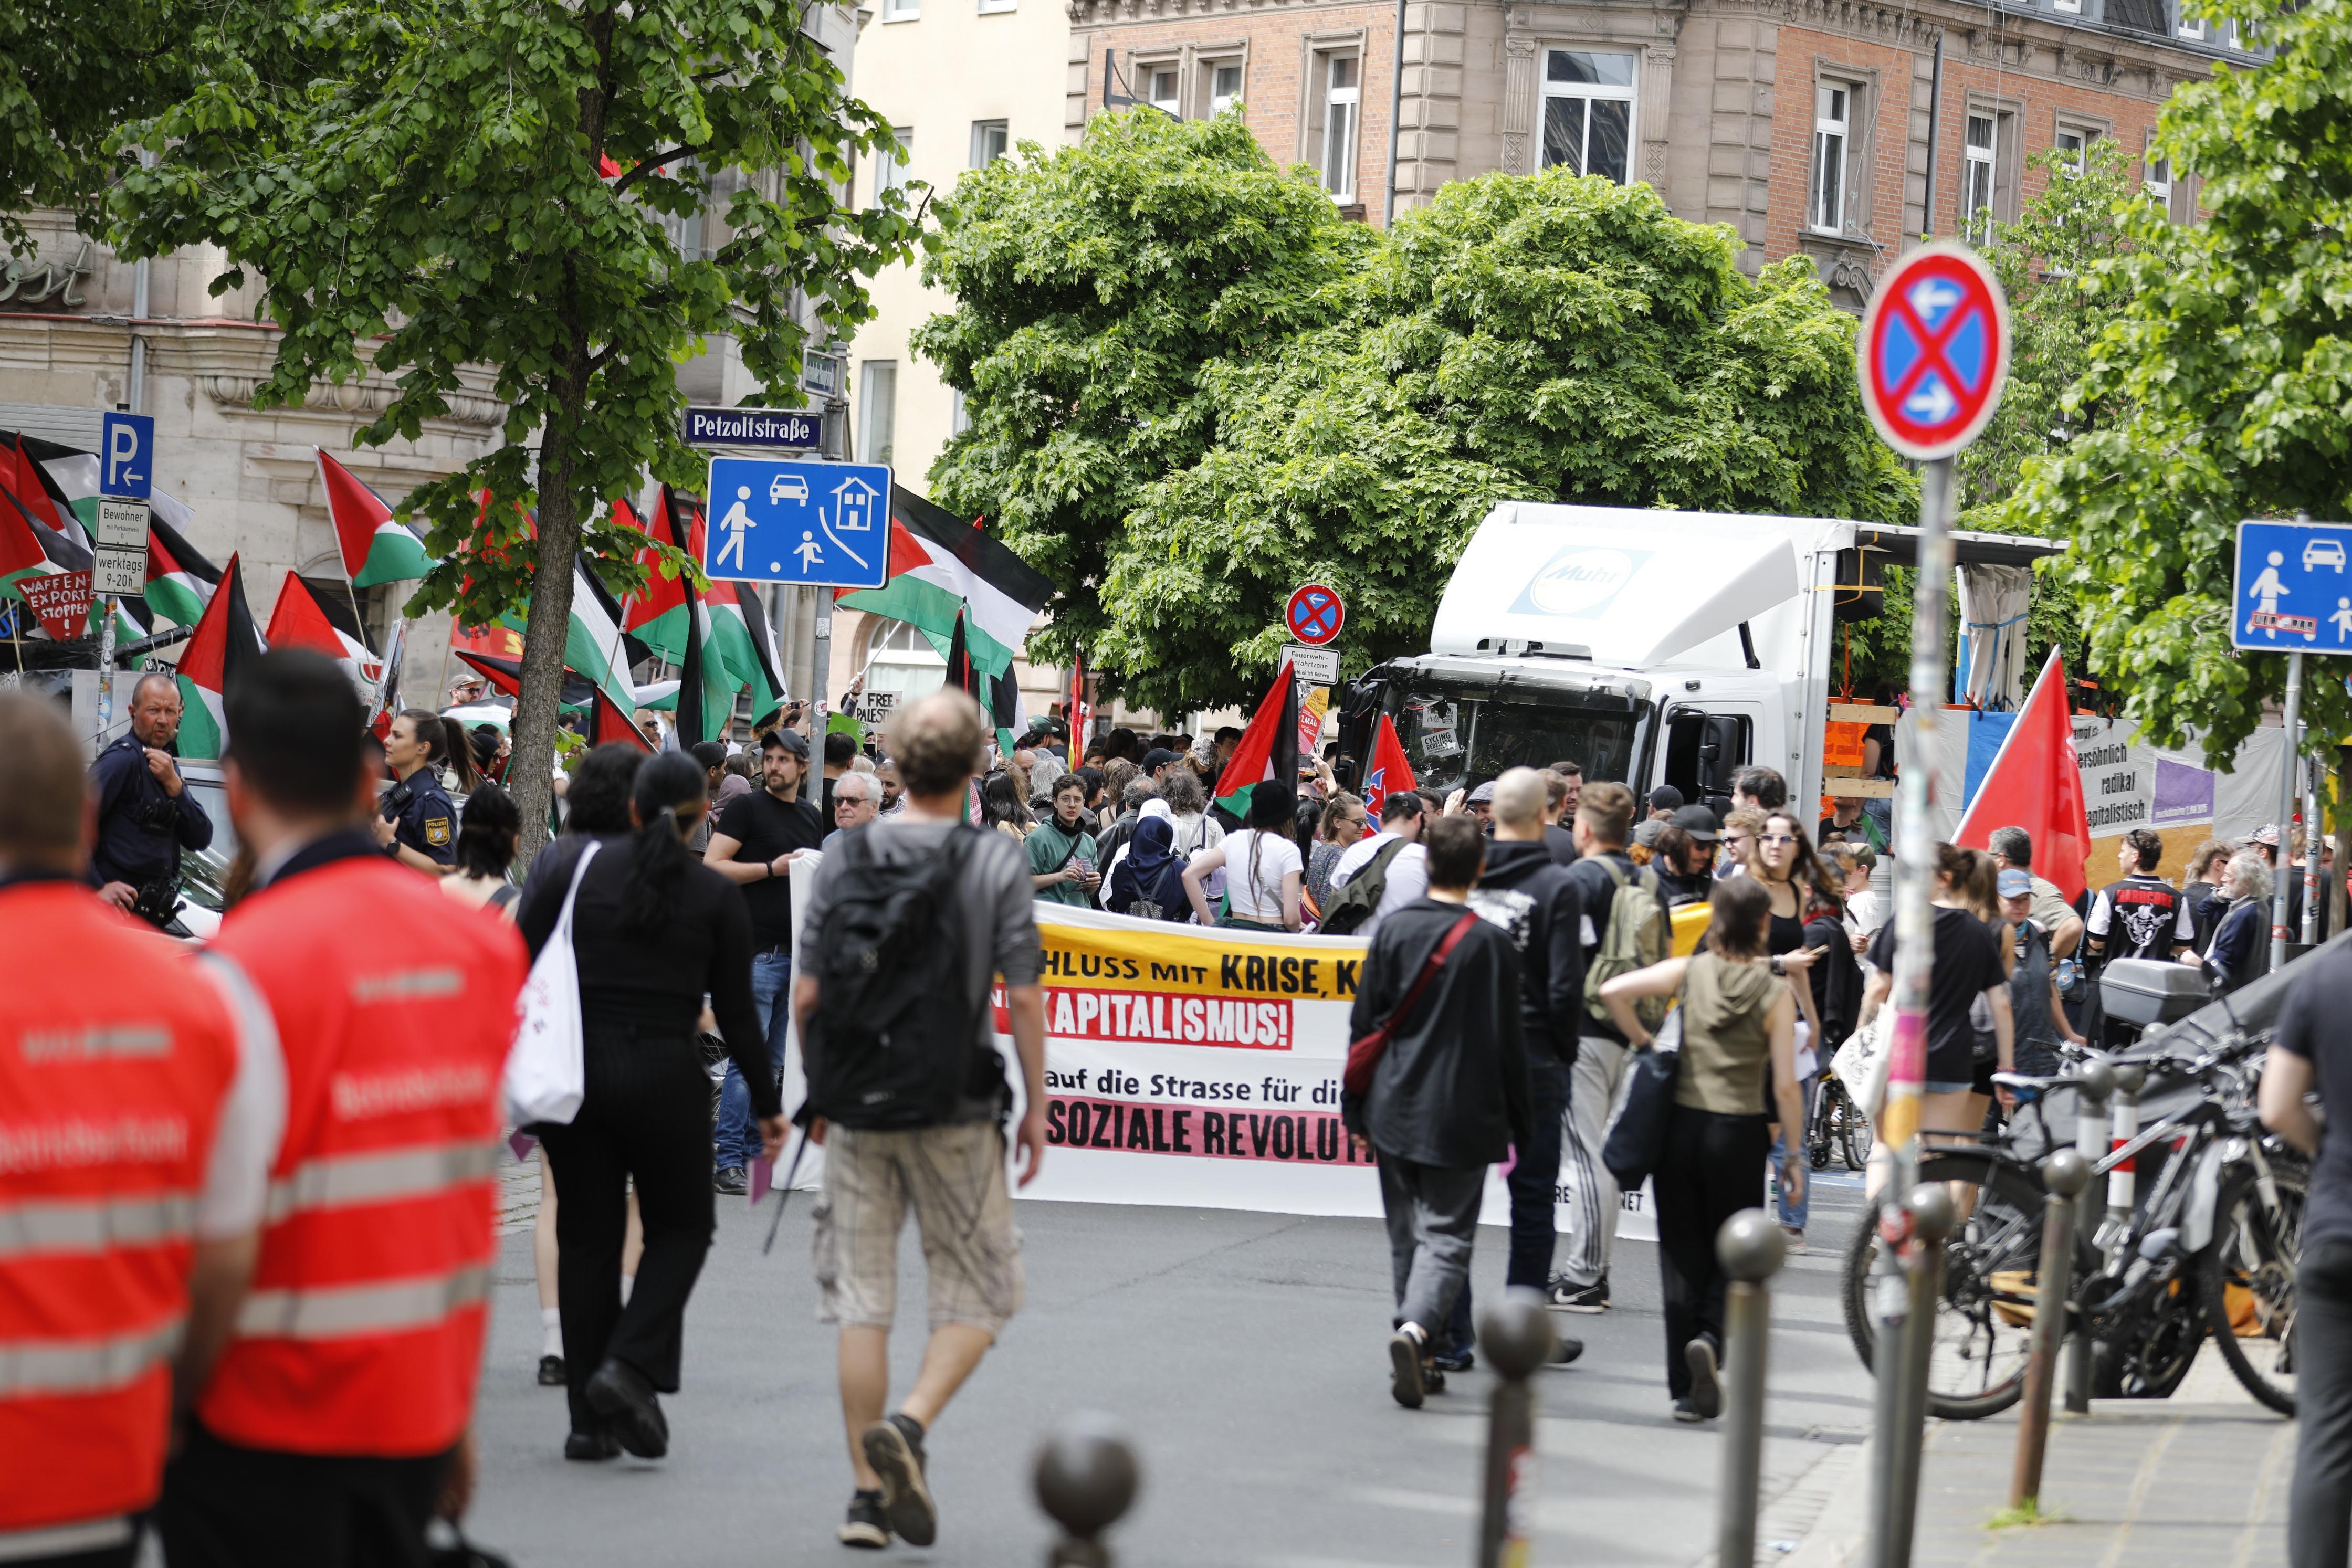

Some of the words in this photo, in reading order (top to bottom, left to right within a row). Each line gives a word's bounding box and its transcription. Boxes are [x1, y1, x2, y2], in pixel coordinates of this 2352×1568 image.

[694, 415, 810, 441] Petzoltstraße
[109, 423, 138, 485] P
[104, 508, 144, 522] Bewohner
[114, 525, 140, 533] Parkausweis
[99, 557, 143, 574] werktags
[1544, 565, 1622, 583] Muhr
[20, 575, 91, 595] WAFFEN-
[107, 573, 133, 588] 9-20h
[30, 588, 96, 608] EXPORTE
[41, 603, 91, 620] STOPPEN
[1291, 651, 1329, 660] Feuerwehr-
[1294, 660, 1328, 669] nfahrtzone
[868, 693, 894, 708] FREE
[1425, 732, 1451, 745] CYCLING
[2077, 742, 2127, 769] ersöhnlich
[2102, 771, 2136, 795] radikal
[2086, 799, 2145, 829] apitalistisch
[1039, 950, 1140, 980] HLUSS
[1150, 962, 1208, 984] MIT
[1221, 954, 1328, 999] KRISE,
[1336, 959, 1367, 995] K
[1044, 1068, 1088, 1089] auf
[1097, 1069, 1139, 1095] die
[1150, 1074, 1251, 1100] Strasse
[1261, 1077, 1303, 1103] für
[1046, 1100, 1192, 1153] SOZIALE
